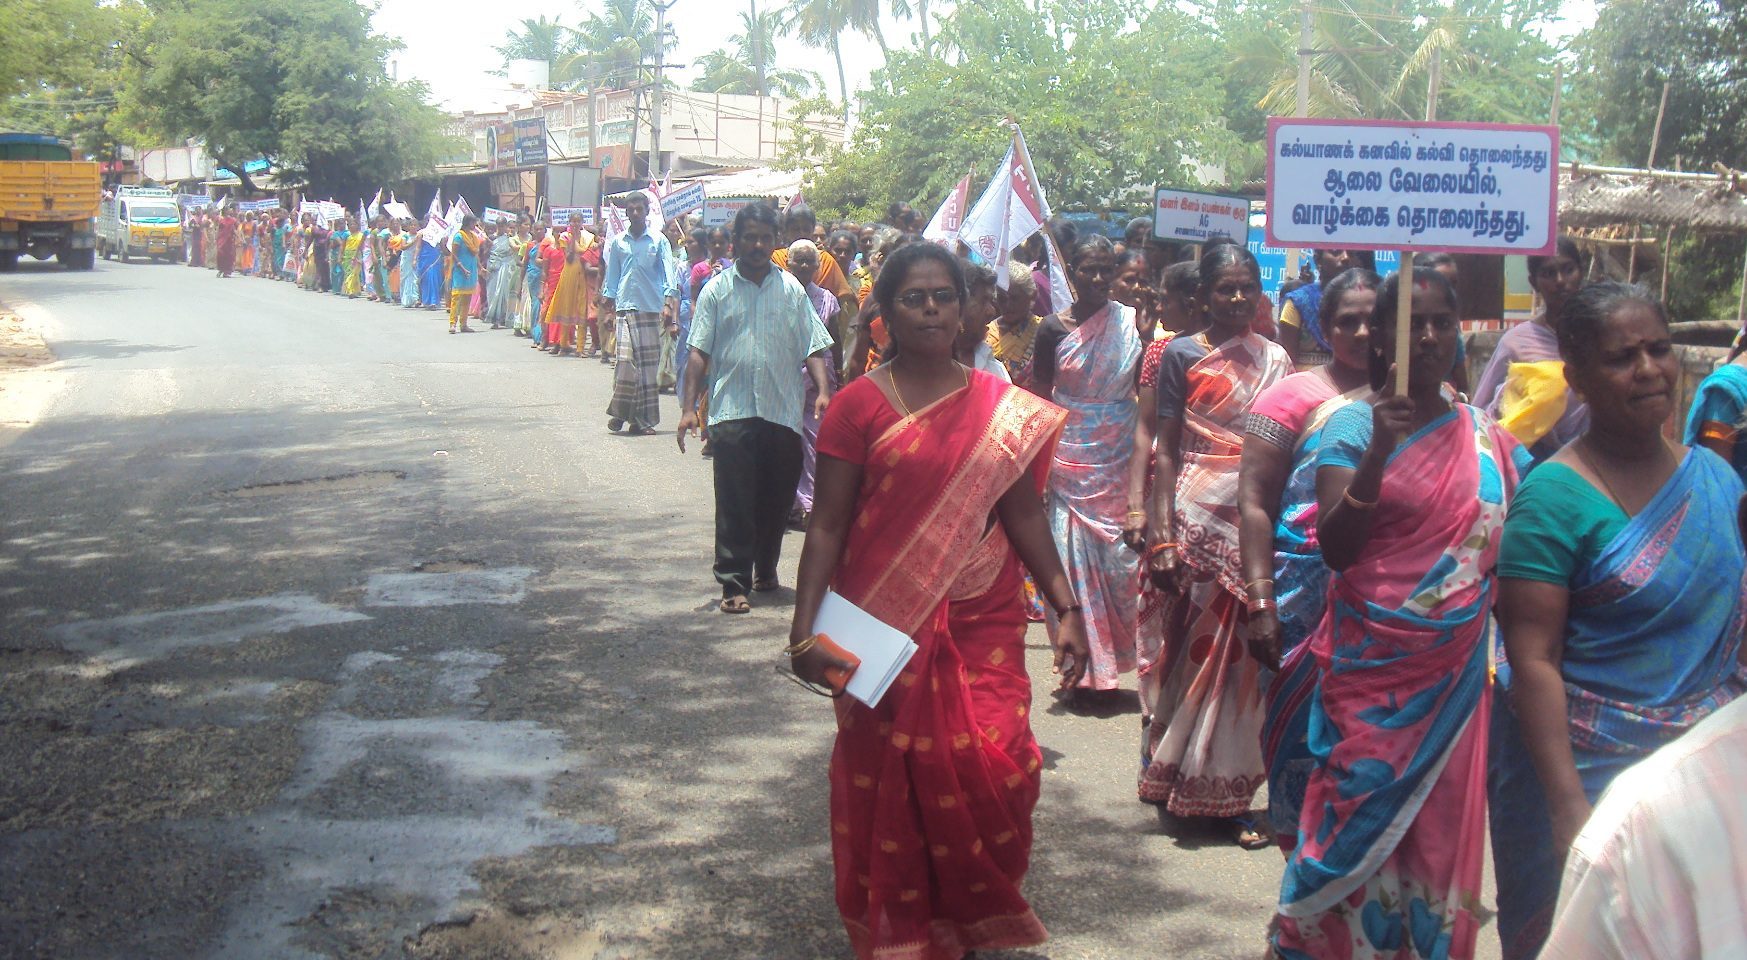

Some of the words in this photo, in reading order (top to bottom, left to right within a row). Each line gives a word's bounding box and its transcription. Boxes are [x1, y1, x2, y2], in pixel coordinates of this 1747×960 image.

[1280, 138, 1354, 159] கல்யாணக்
[1358, 140, 1412, 161] கனவில்
[1416, 142, 1455, 162] கல்வி
[1459, 144, 1547, 172] தொலைந்தது
[1324, 168, 1382, 198] ஆலை
[1389, 167, 1502, 197] வேலையில்,
[1292, 198, 1390, 234] வாழ்க்கை
[1397, 202, 1530, 243] தொலைந்தது.
